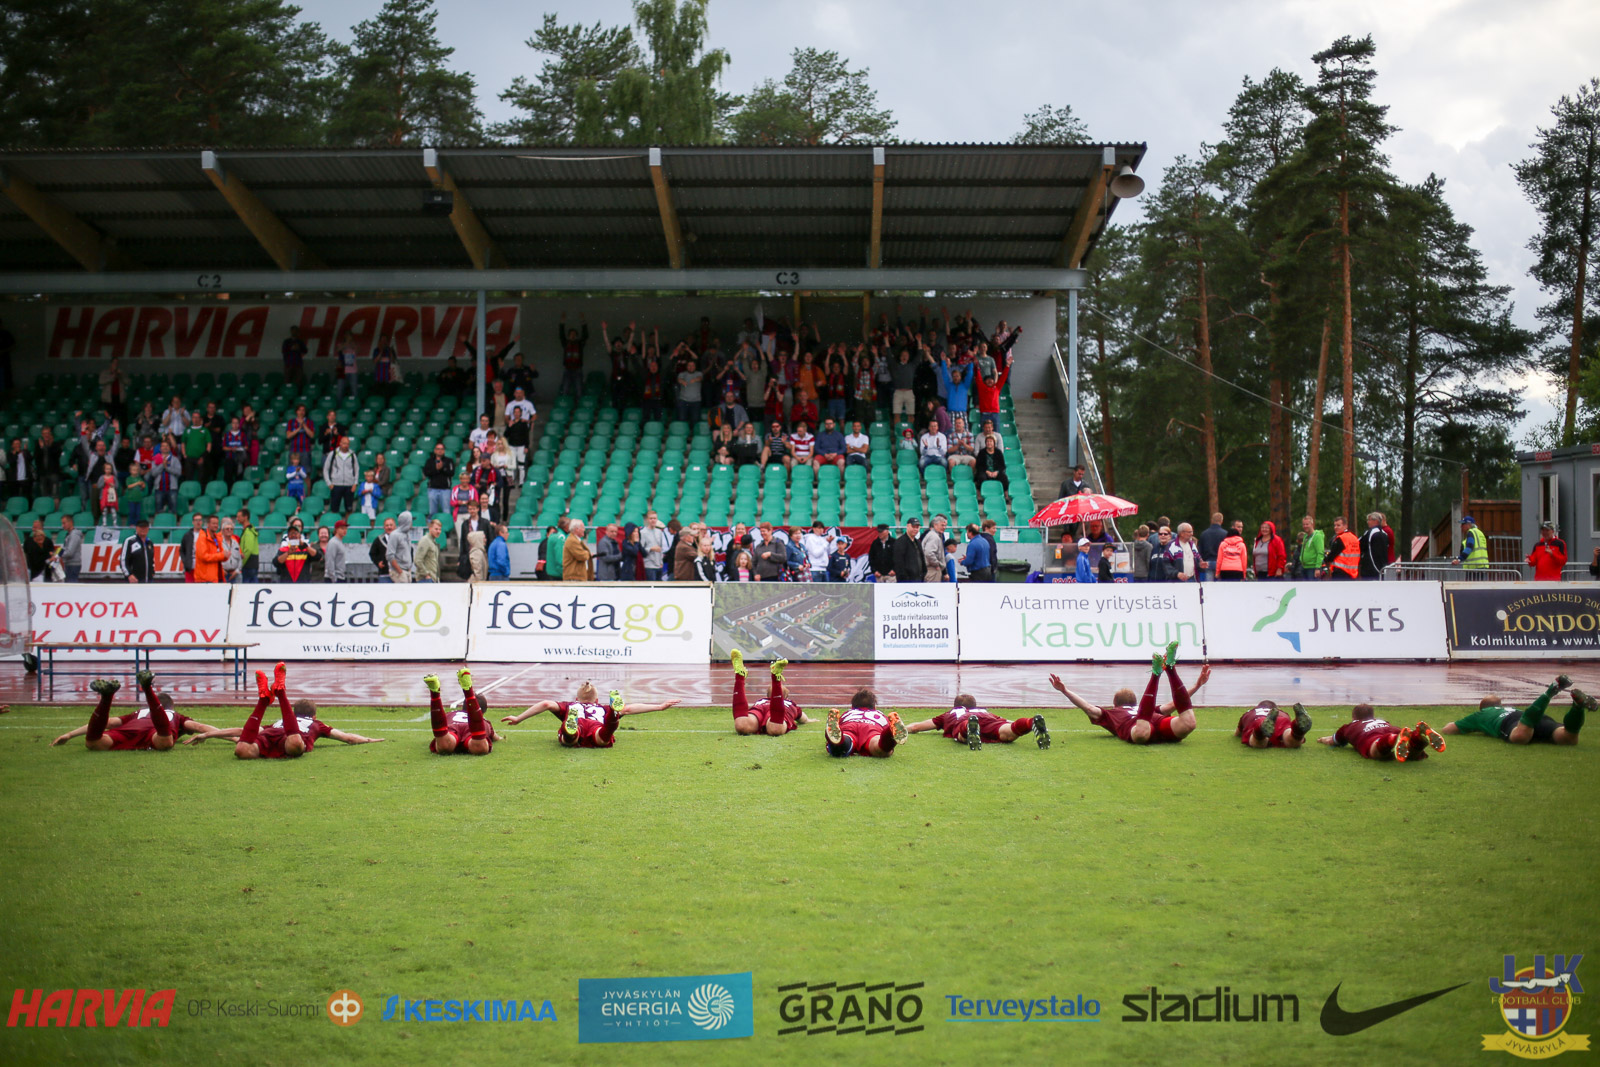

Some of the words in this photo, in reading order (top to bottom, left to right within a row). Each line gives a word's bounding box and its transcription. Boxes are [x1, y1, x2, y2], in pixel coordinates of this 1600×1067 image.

[197, 274, 222, 288] C2
[775, 271, 800, 285] C3
[47, 305, 270, 358] HARVIA
[296, 304, 519, 358] HARVIA
[101, 532, 114, 541] C2
[42, 601, 139, 619] TOYOTA
[247, 587, 443, 638] festago
[891, 600, 939, 608] Loistokoti.fi
[1001, 595, 1090, 611] Autamme
[1095, 595, 1178, 614] yritystäsi
[1507, 593, 1583, 614] ESTABLISHED
[486, 589, 685, 642] festago
[883, 614, 891, 622] 33
[1308, 608, 1405, 633] JYKES
[1502, 613, 1600, 633] LONDO
[883, 623, 949, 640] Palokkaan
[1022, 613, 1202, 648] kasvuun
[67, 629, 163, 654] AUTO
[173, 629, 221, 654] OY
[302, 642, 391, 656] www.festago.fi
[1470, 635, 1548, 646] Kolmikulma
[542, 645, 633, 659] www.festago.fi
